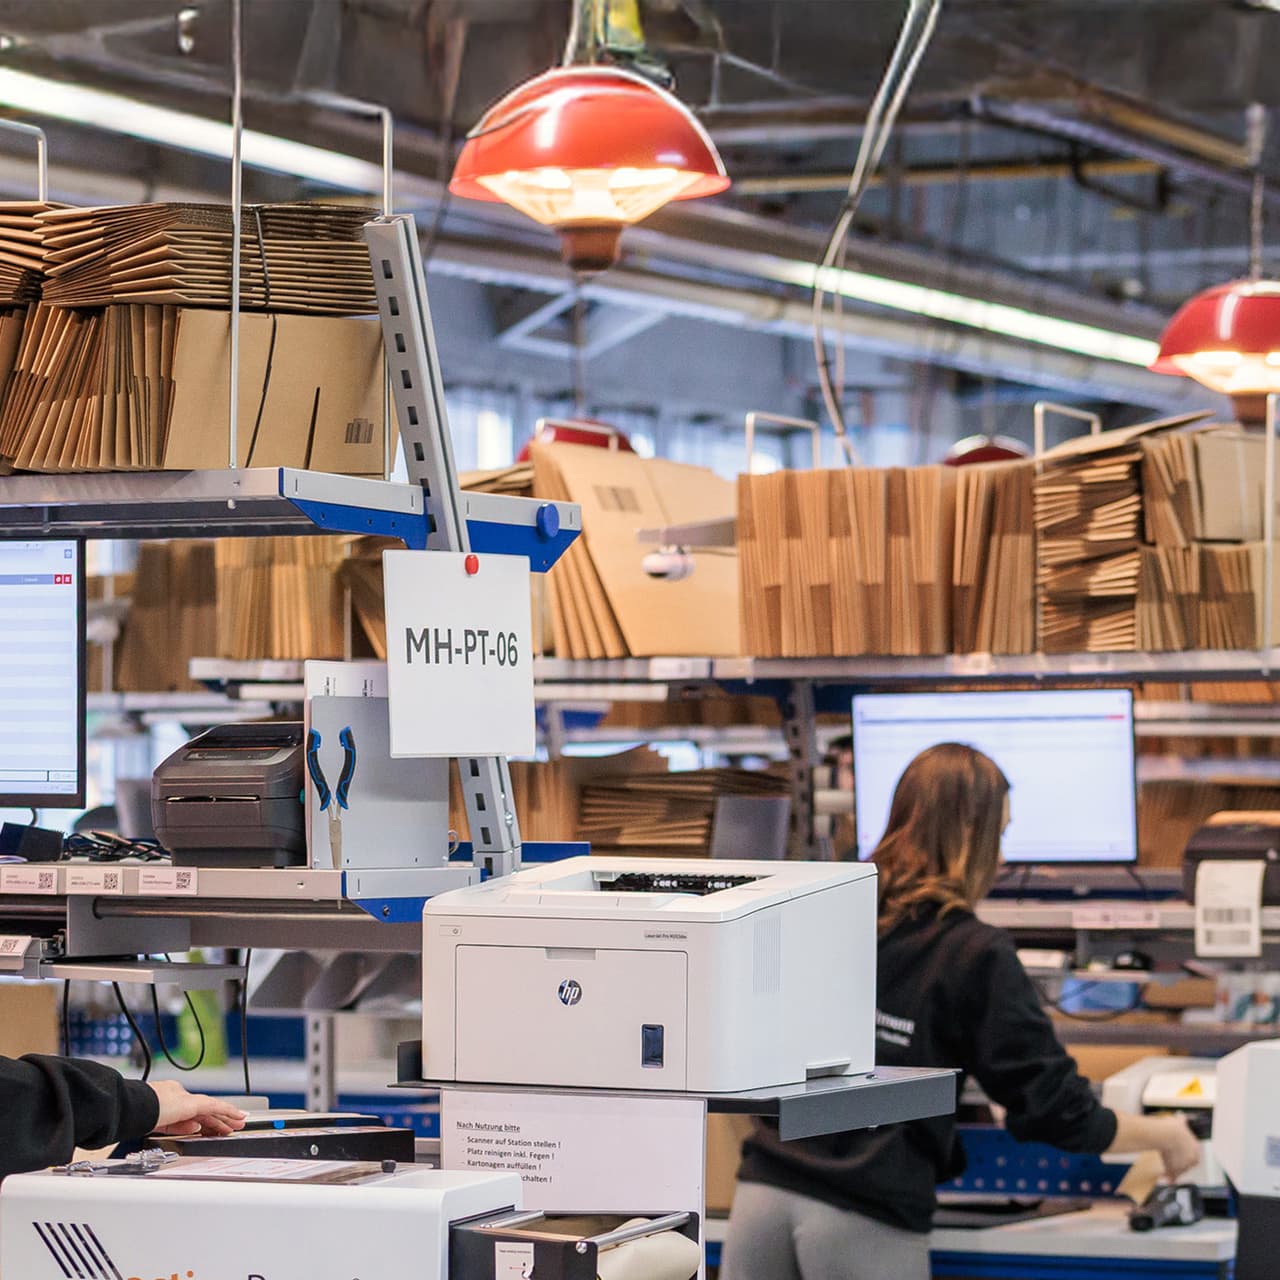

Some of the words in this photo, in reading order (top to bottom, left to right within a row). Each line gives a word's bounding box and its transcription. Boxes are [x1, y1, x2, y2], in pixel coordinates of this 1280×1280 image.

[405, 627, 518, 667] MH-PT-06
[560, 980, 581, 1006] hp
[456, 1121, 473, 1129] Nach
[475, 1123, 503, 1132] Nutzung
[504, 1124, 520, 1132] bitte
[467, 1136, 493, 1144] Scanner
[507, 1139, 532, 1147] Station
[533, 1140, 556, 1148] stellen
[484, 1149, 512, 1158] reinigen
[529, 1152, 550, 1160] Fegen
[467, 1160, 505, 1169] Kartonagen
